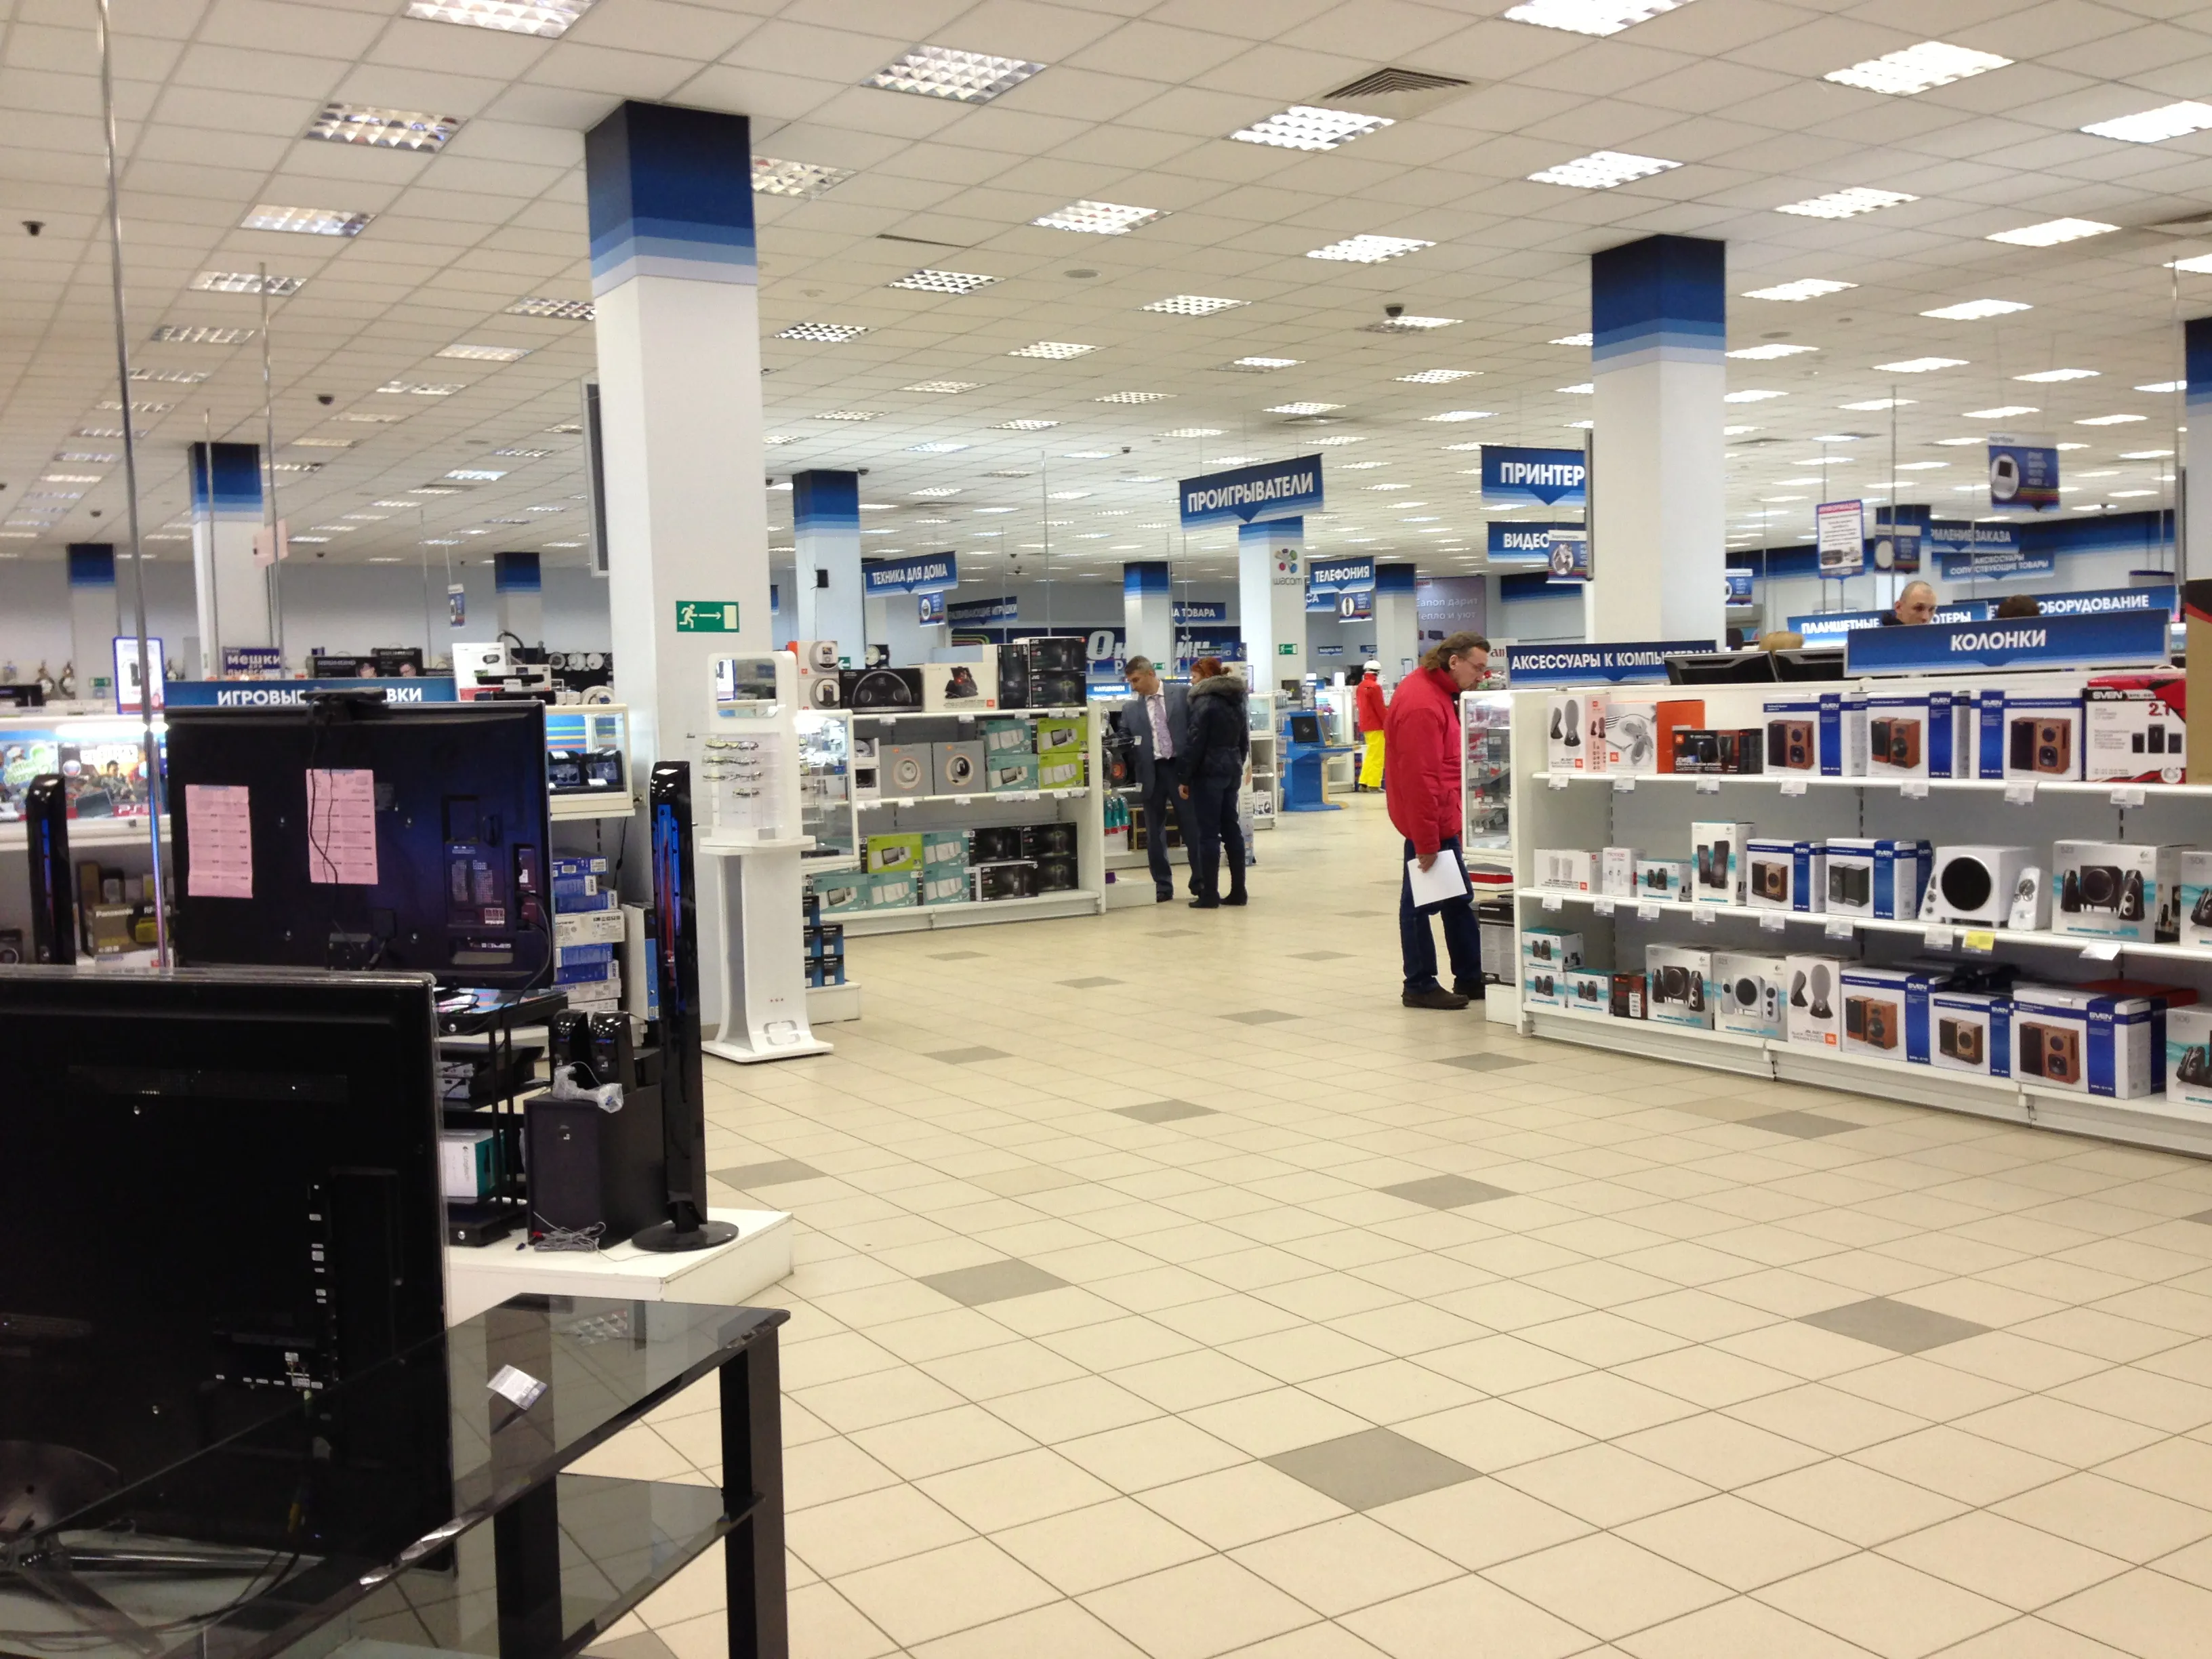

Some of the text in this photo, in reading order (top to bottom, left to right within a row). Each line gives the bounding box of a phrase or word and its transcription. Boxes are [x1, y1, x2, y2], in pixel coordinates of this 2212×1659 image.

[1187, 472, 1314, 513] ПРОИГРЫВАТЕЛИ
[1975, 530, 2011, 542] ЗАКАЗА
[1314, 565, 1370, 583] ТЕЛЕФОНИЯ
[1950, 560, 2049, 575] СОПУСТВУЮЩИЕ ТОВАРЫ
[872, 563, 948, 586] ТЕХНИКА ДЛЯ ДОМА
[1273, 576, 1303, 586] wacom
[1448, 598, 1478, 607] дарит
[1181, 608, 1216, 617] ТОВАРА
[1456, 612, 1477, 621] уют
[1801, 617, 1879, 634] ПЛАНШЕТНЫЕ
[1950, 629, 2047, 652] КОЛОНКИ
[1511, 653, 1601, 670] АКСЕССУАРЫ
[1605, 652, 1614, 668] К
[217, 687, 422, 705] ИГРОВЫЕ ВКИ
[2093, 691, 2123, 699] SVEN
[1908, 983, 1927, 991] SVEN
[2089, 1012, 2112, 1021] SVEN
